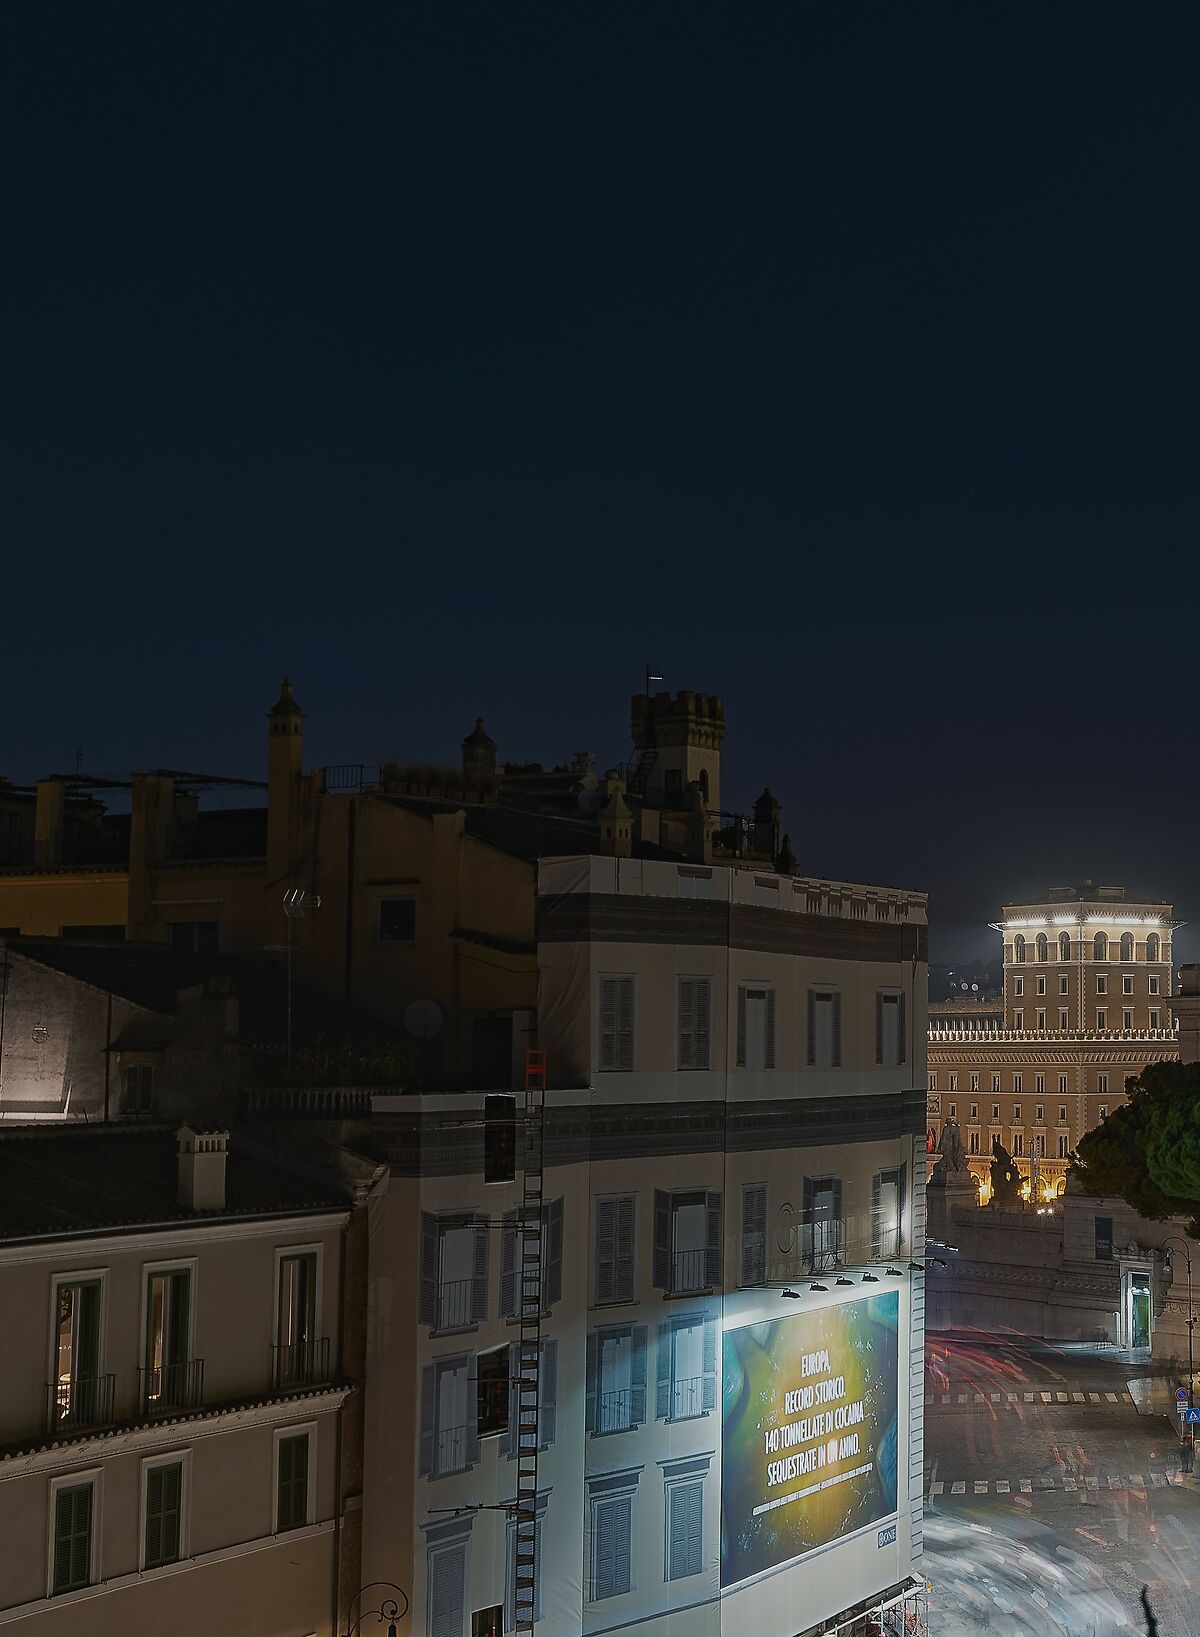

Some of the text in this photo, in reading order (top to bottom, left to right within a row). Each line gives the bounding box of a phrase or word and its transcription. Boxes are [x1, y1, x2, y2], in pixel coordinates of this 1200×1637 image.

[801, 1350, 831, 1378] EUROPA,
[785, 1376, 846, 1415] RECORD STORICO.
[765, 1400, 864, 1454] 140 TONNELLATE DI COCAINA
[768, 1448, 817, 1487] SEQUESTRATE
[818, 1444, 827, 1468] IN
[827, 1439, 838, 1465] UN
[838, 1433, 861, 1459] ANNO.
